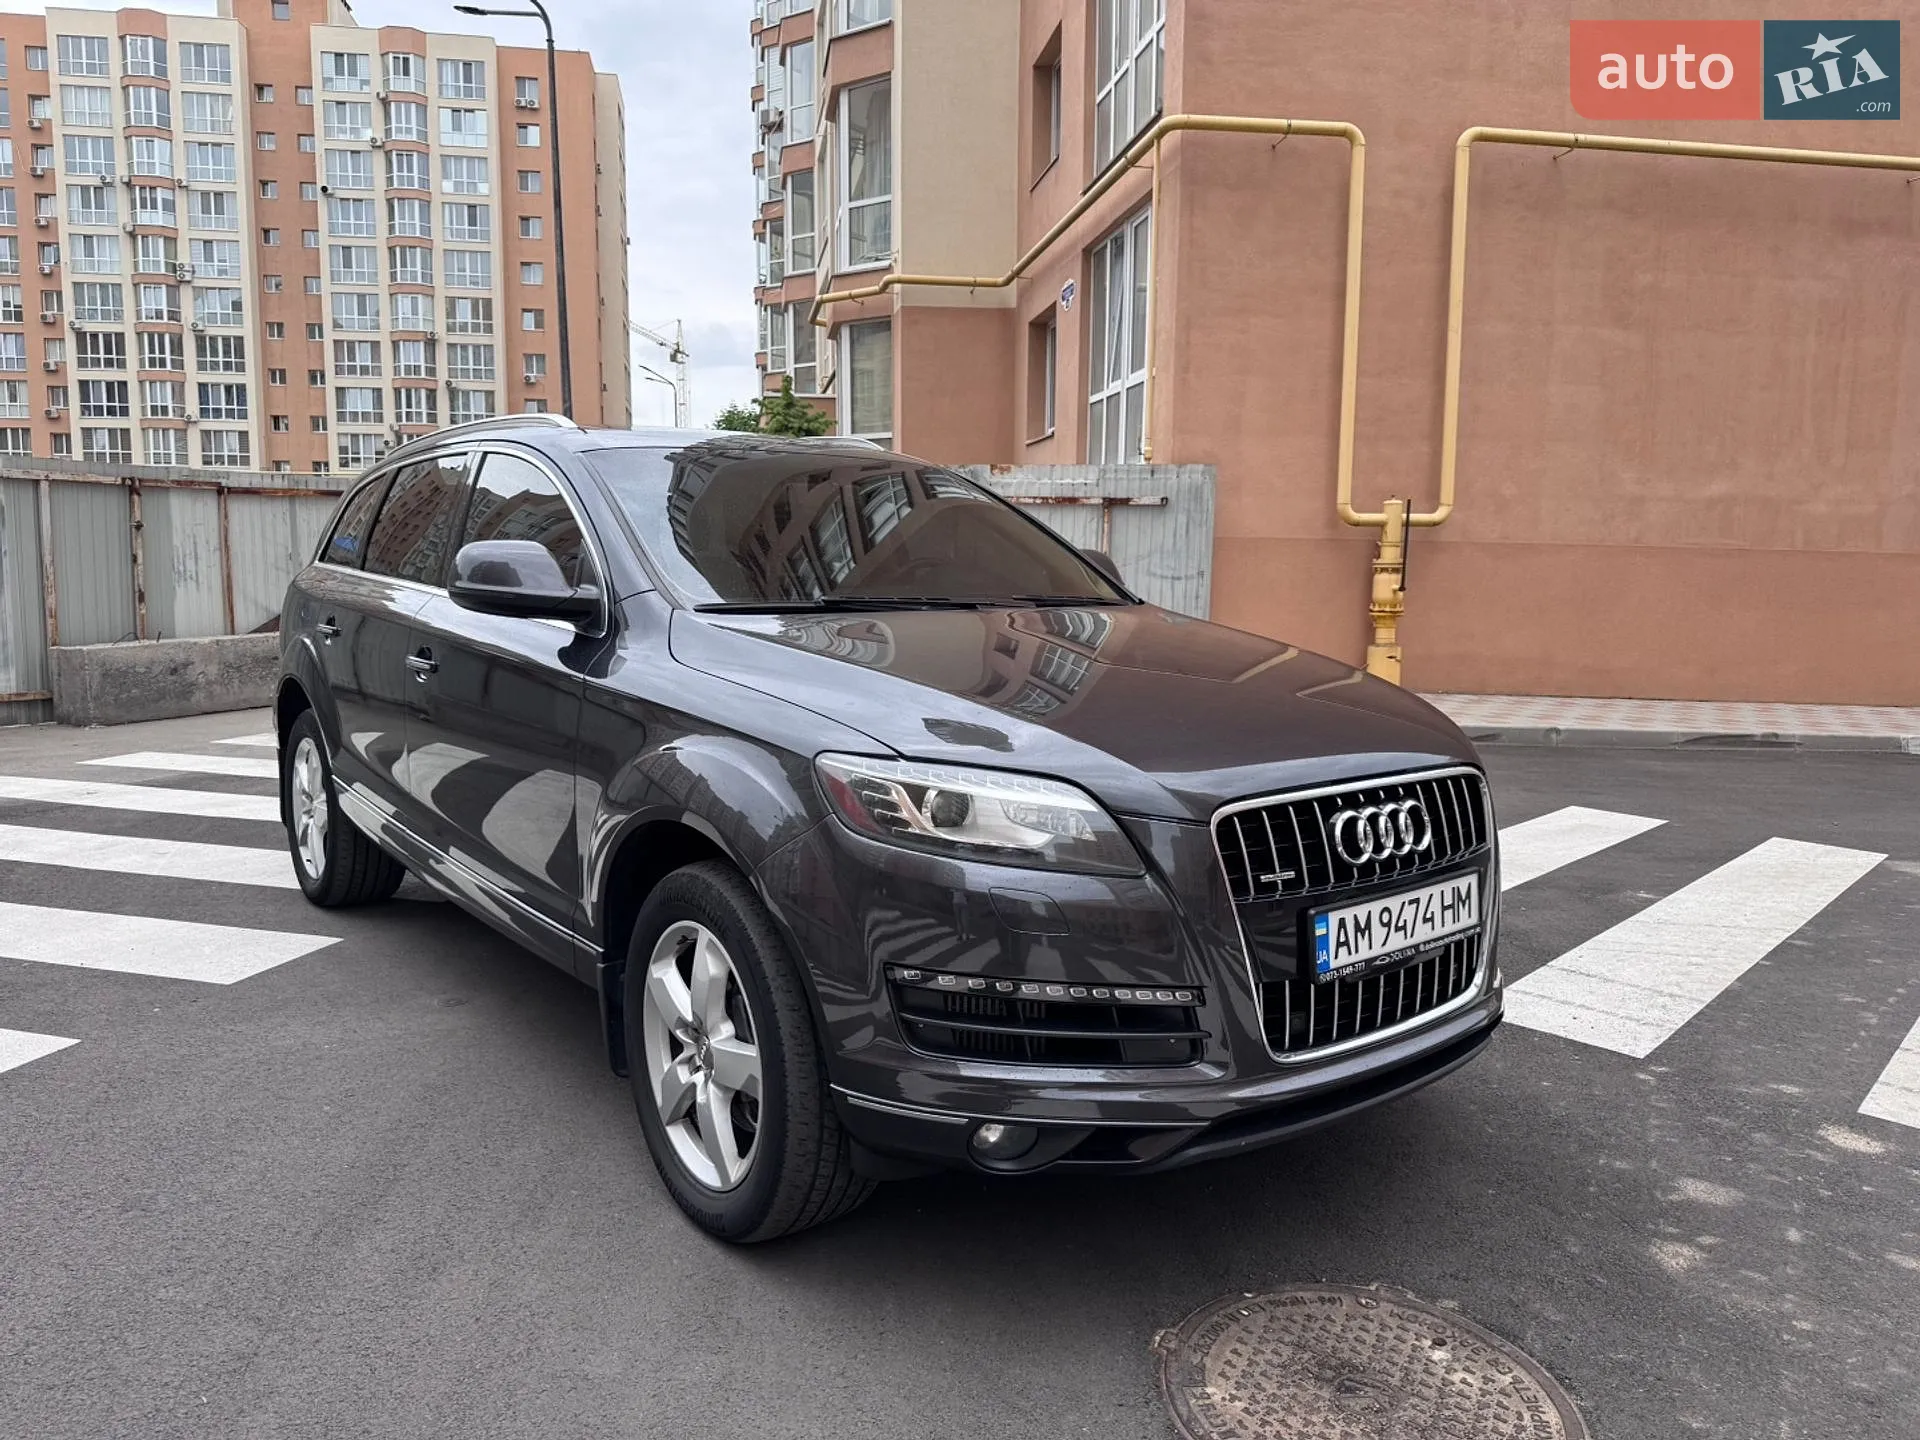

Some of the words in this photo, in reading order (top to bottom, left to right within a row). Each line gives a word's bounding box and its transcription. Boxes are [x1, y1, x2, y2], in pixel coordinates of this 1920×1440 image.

[1334, 910, 1372, 960] AM
[1379, 893, 1435, 948] 9474
[1440, 882, 1471, 928] HM
